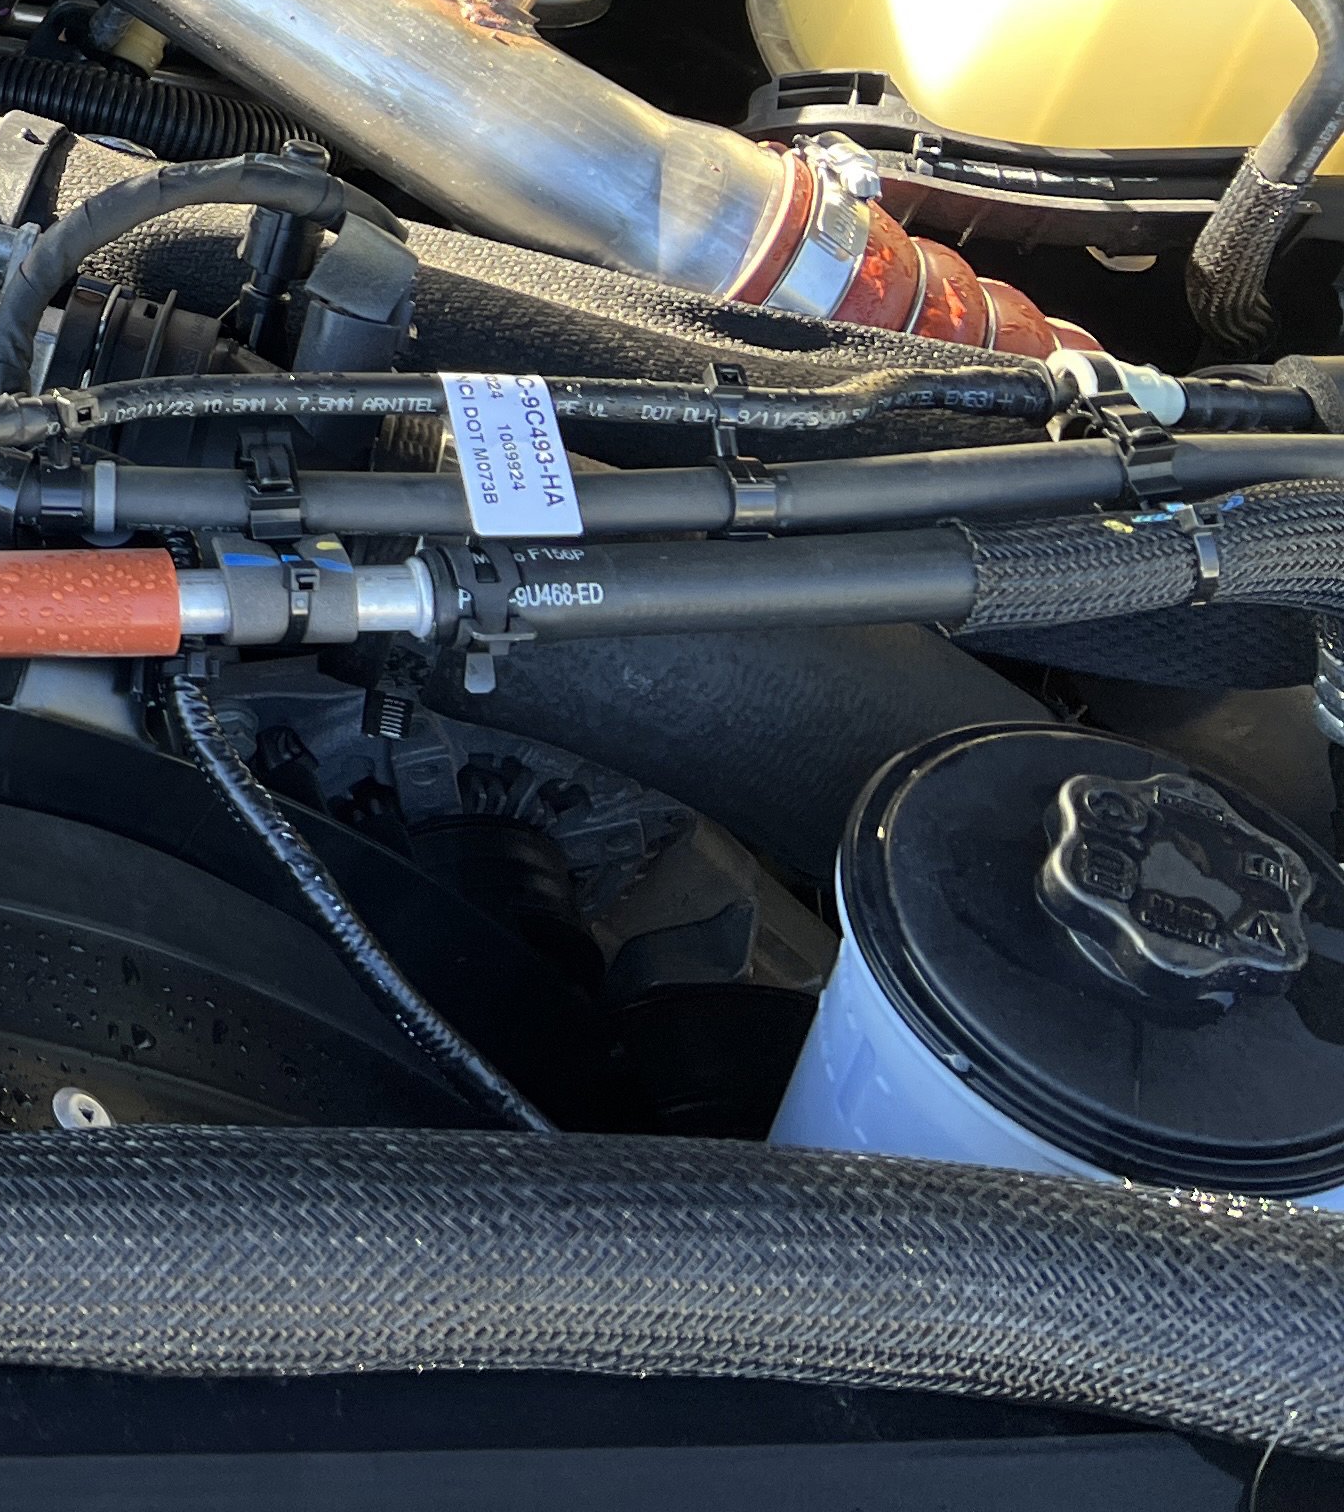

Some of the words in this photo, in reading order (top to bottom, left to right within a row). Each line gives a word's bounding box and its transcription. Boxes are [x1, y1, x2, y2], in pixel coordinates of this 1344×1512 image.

[273, 397, 289, 412] X
[361, 397, 438, 414] ARNITEL
[463, 406, 486, 443] DOT
[472, 447, 499, 505] M073B
